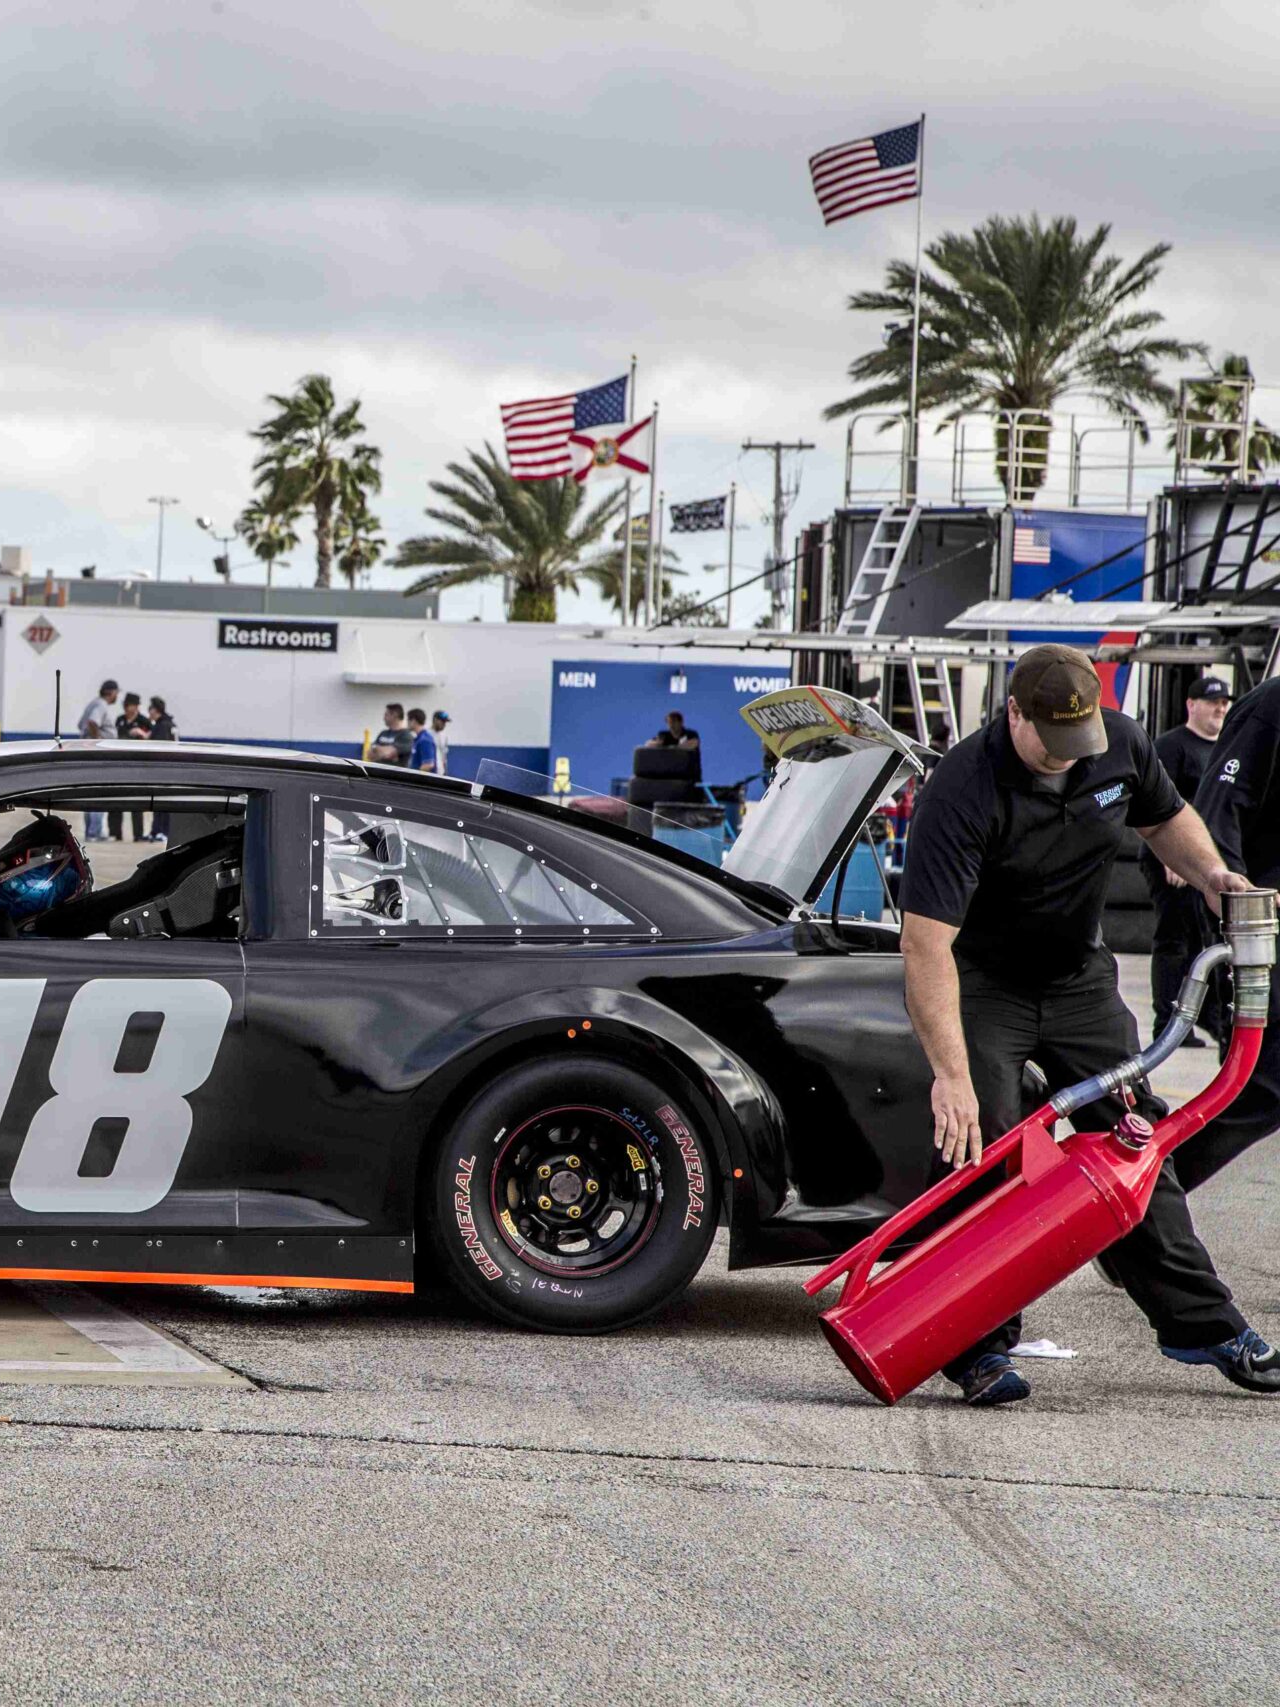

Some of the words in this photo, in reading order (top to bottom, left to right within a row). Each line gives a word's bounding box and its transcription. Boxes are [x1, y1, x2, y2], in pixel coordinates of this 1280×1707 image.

[30, 625, 53, 643] 217
[223, 624, 332, 648] Restrooms
[559, 672, 596, 688] MEN
[750, 700, 827, 734] MENARDS
[655, 1104, 705, 1231] GENERAL
[455, 1155, 502, 1280] GENERAL
